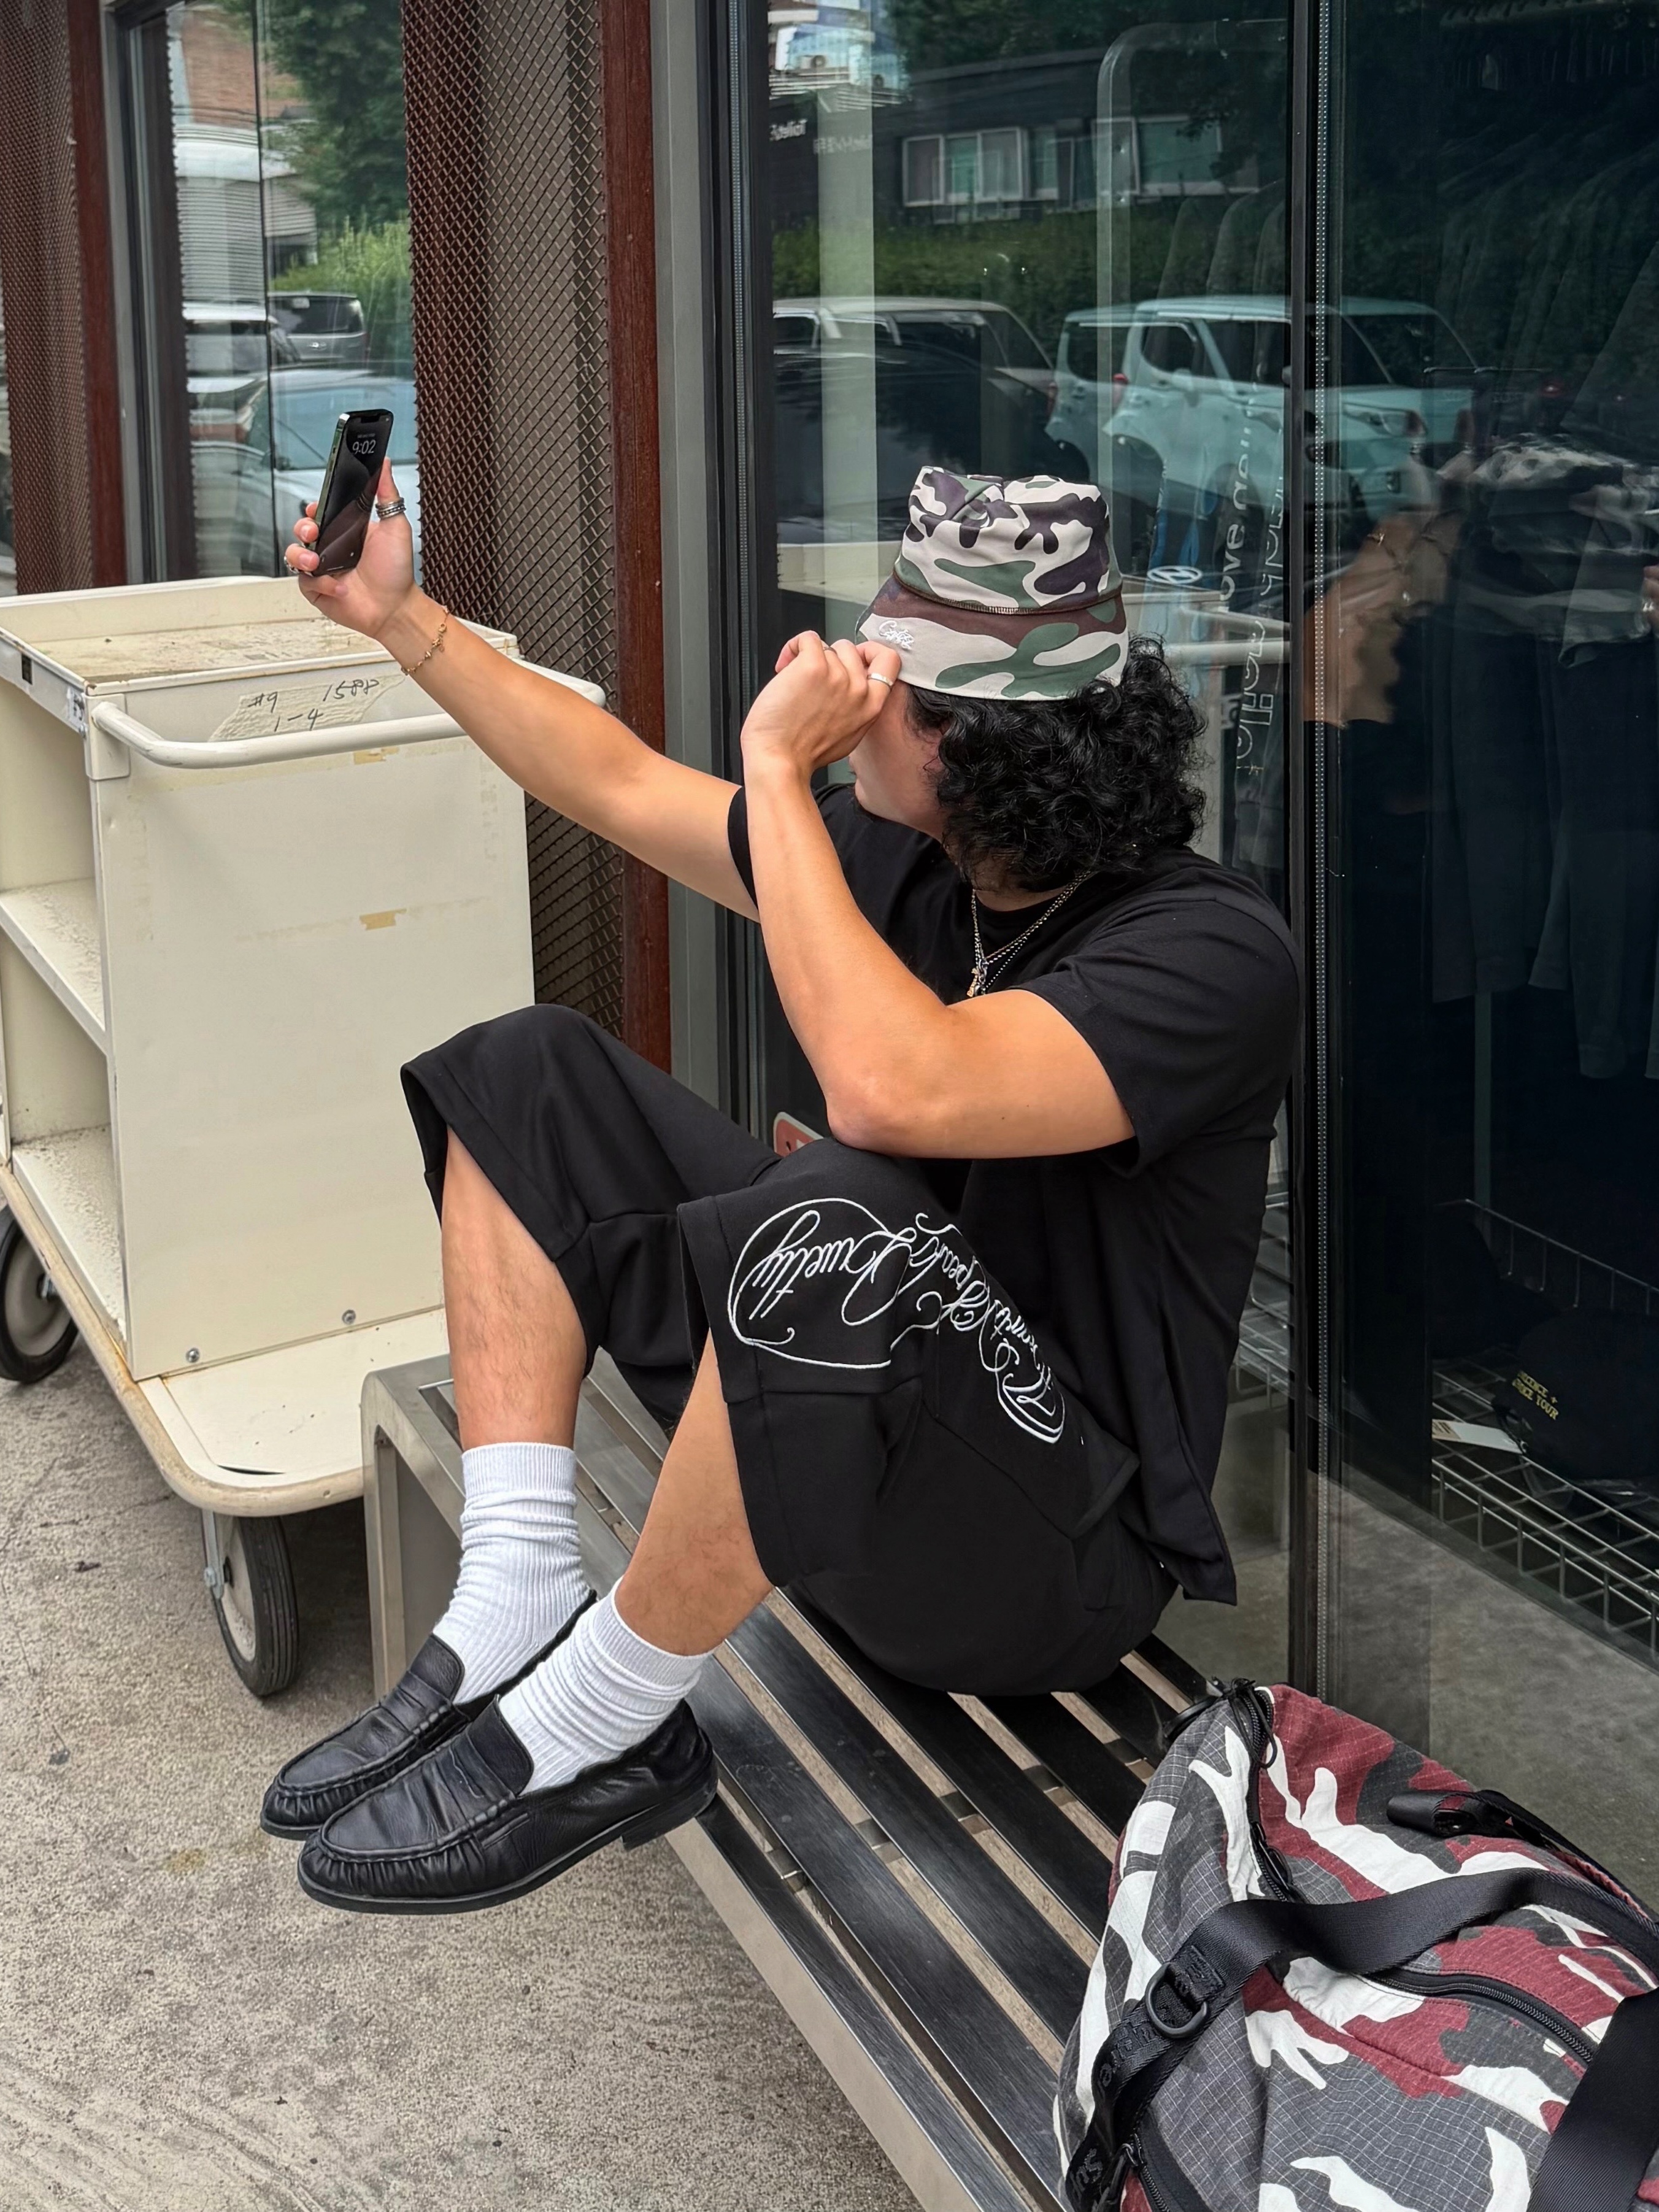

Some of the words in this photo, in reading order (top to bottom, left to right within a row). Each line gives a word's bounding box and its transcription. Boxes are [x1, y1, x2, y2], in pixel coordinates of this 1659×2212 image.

[352, 439, 376, 455] 9:02
[247, 692, 278, 713] #9
[1536, 1394, 1559, 1420] YOUR
